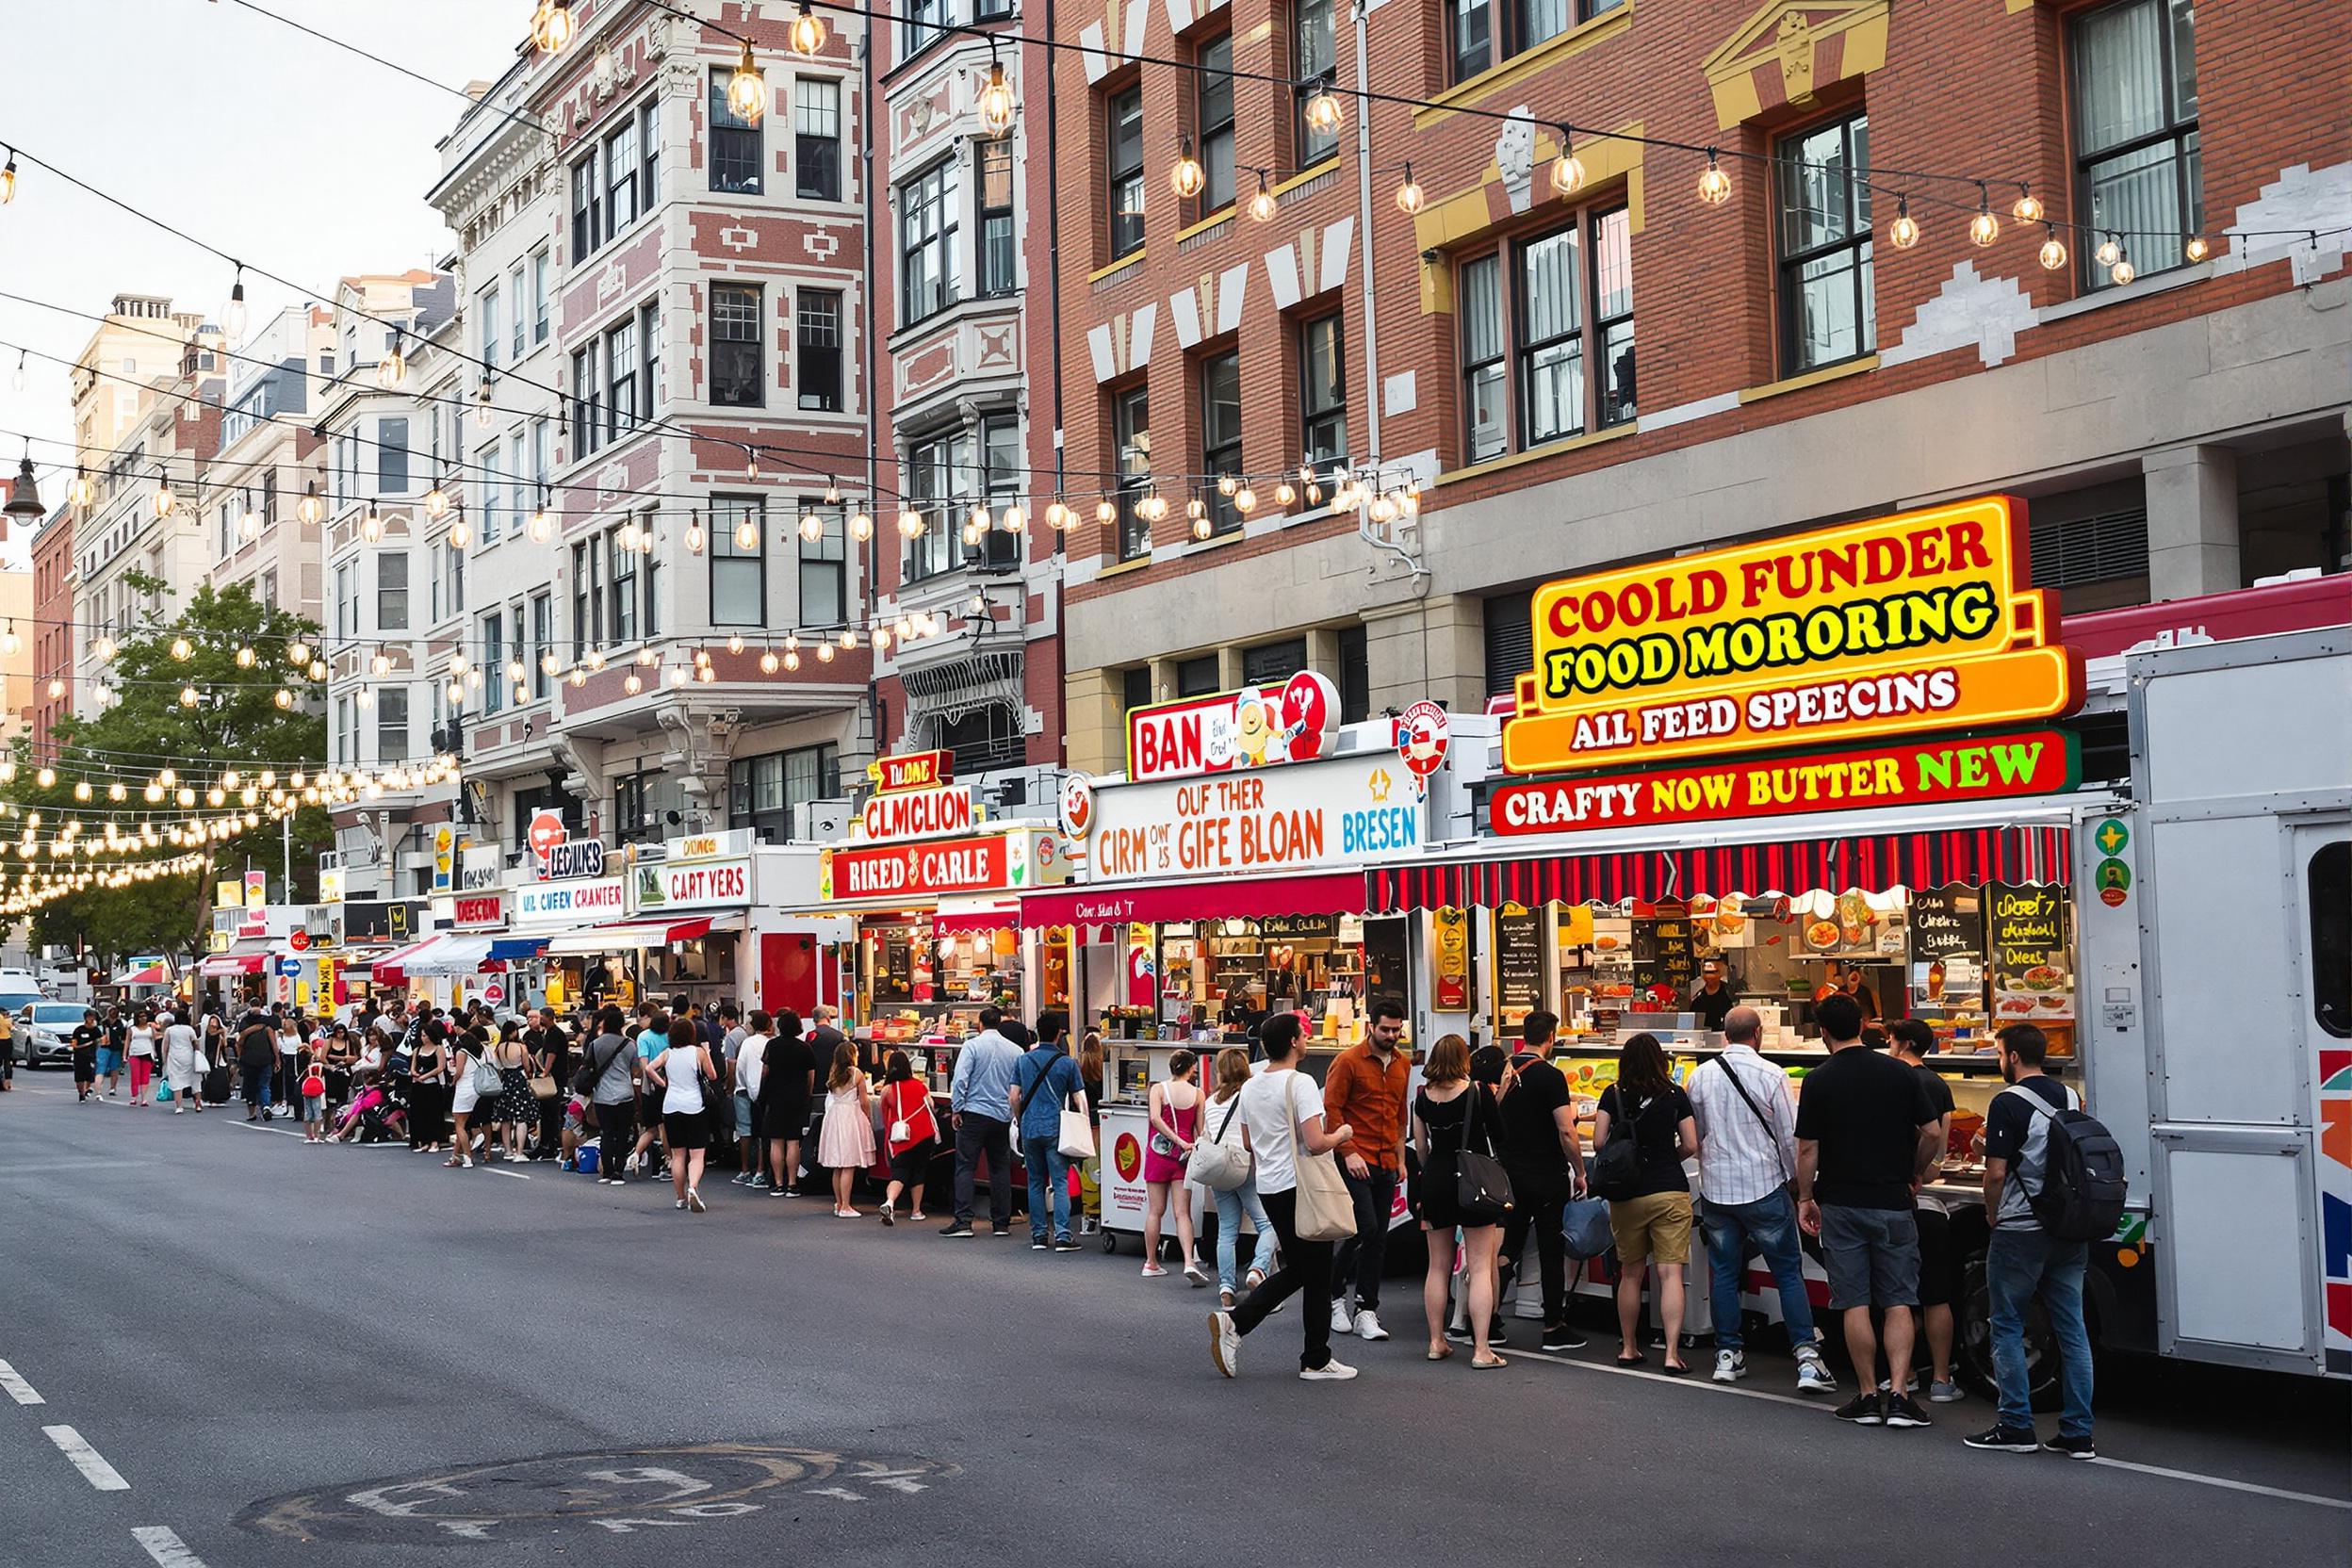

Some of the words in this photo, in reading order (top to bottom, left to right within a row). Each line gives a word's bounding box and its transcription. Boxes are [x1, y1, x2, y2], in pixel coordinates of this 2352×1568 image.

[1548, 569, 1727, 638] COOLD
[1740, 520, 1993, 607] FUNDER
[1545, 641, 1681, 695] FOOD
[1685, 584, 1996, 677] MORORING
[1571, 712, 1633, 750] ALL
[1642, 698, 1738, 743] FEED
[1748, 670, 1957, 728] SPEECINS
[1140, 713, 1200, 774] BAN
[1177, 783, 1211, 817] OUF
[1217, 778, 1264, 811] THER
[1505, 781, 1640, 826] CRAFTY
[1651, 772, 1737, 813] NOW
[1747, 758, 1904, 806] BUTTER
[1917, 742, 2044, 792] NEW
[1100, 828, 1147, 875] CIRM
[1178, 808, 1232, 871] GIFE
[1240, 801, 1323, 865] BLOAN
[1343, 806, 1415, 854] BRESEN
[923, 847, 990, 887] CARLE
